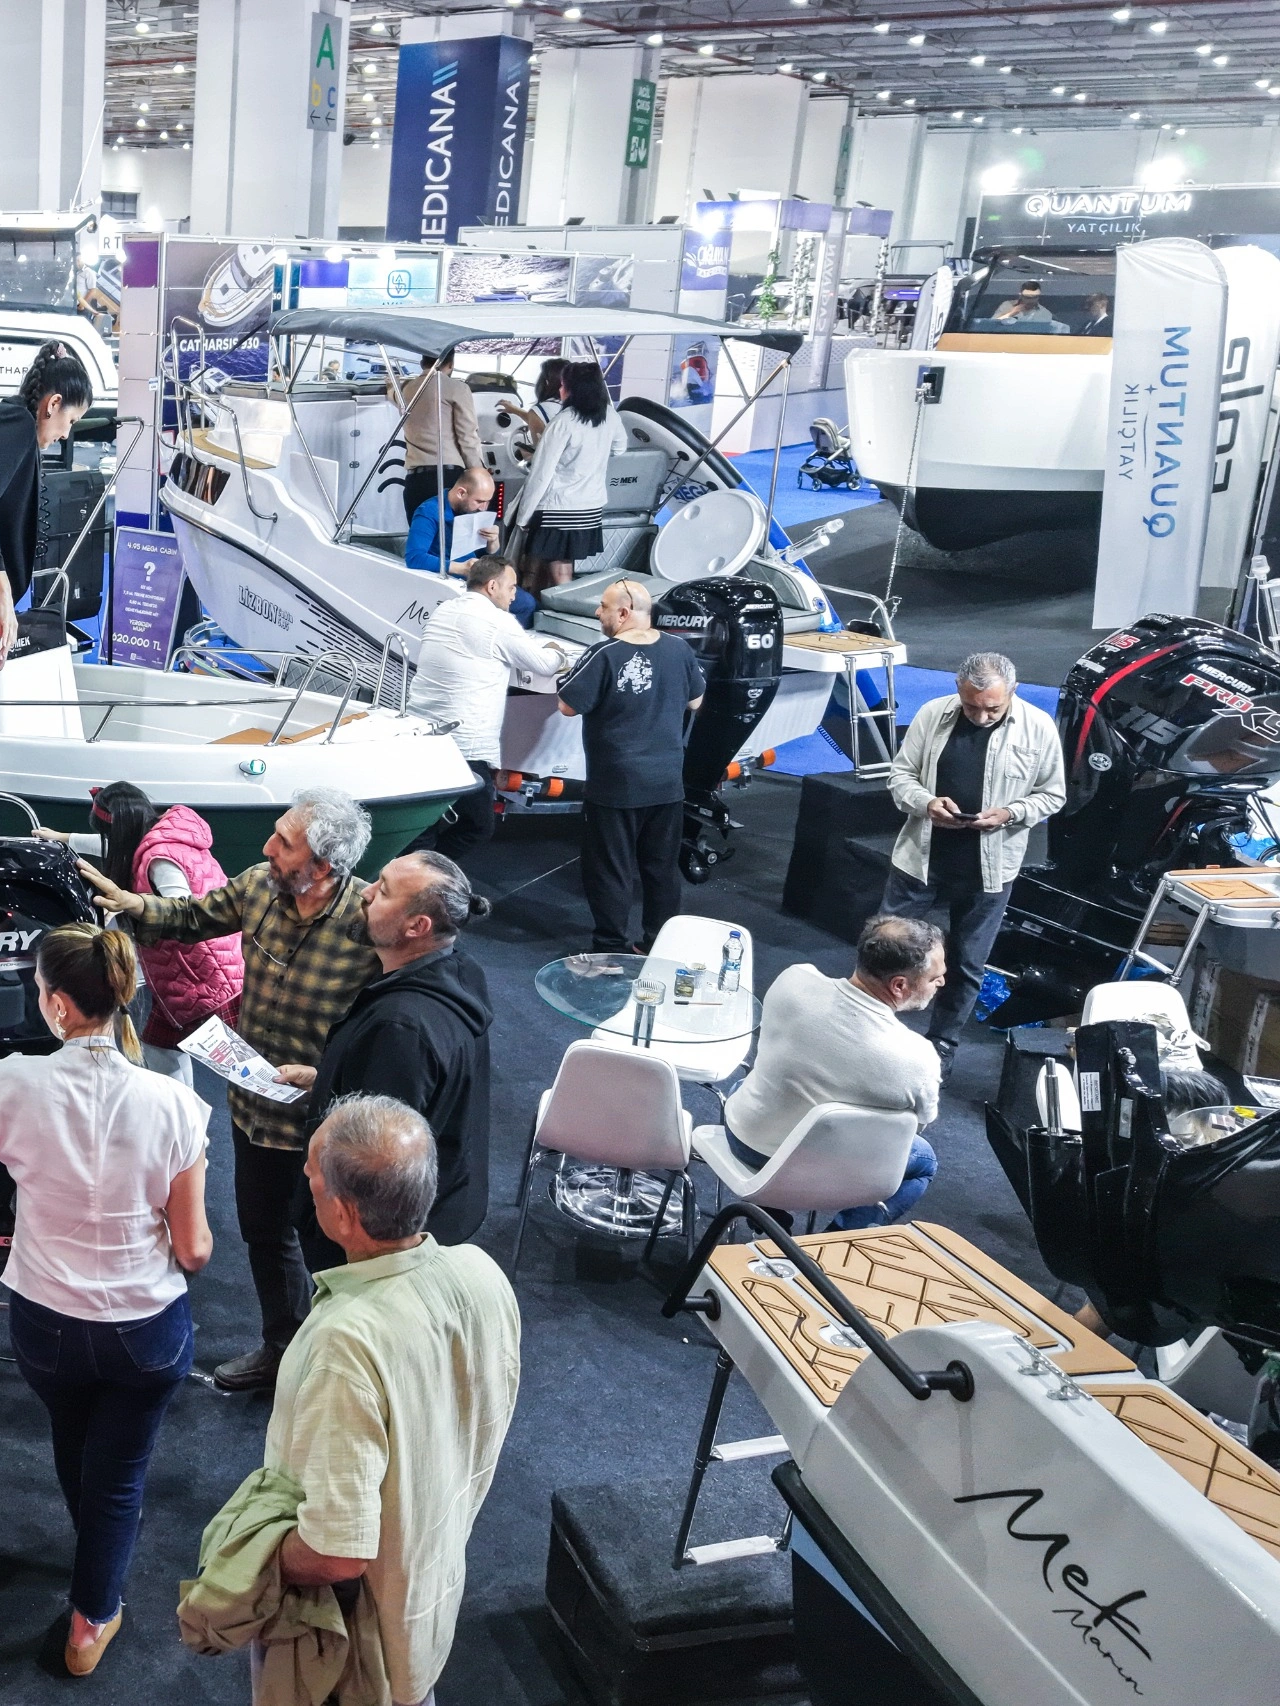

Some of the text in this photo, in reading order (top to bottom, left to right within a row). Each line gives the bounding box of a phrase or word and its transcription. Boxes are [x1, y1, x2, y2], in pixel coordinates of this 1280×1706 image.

[316, 23, 335, 70] A
[312, 78, 336, 108] b c
[420, 81, 458, 245] EDICANA
[494, 81, 520, 226] EDICANA
[1025, 193, 1193, 217] QUANTUM
[1067, 223, 1141, 235] YATÇILIK
[179, 336, 239, 352] CATHARSIS
[619, 476, 638, 484] MEK
[238, 585, 279, 625] LİZBON
[656, 615, 714, 627] MERCURY
[153, 640, 162, 651] TL
[747, 634, 774, 650] 60
[1197, 663, 1257, 694] MERCURY
[1179, 673, 1255, 713] PRO
